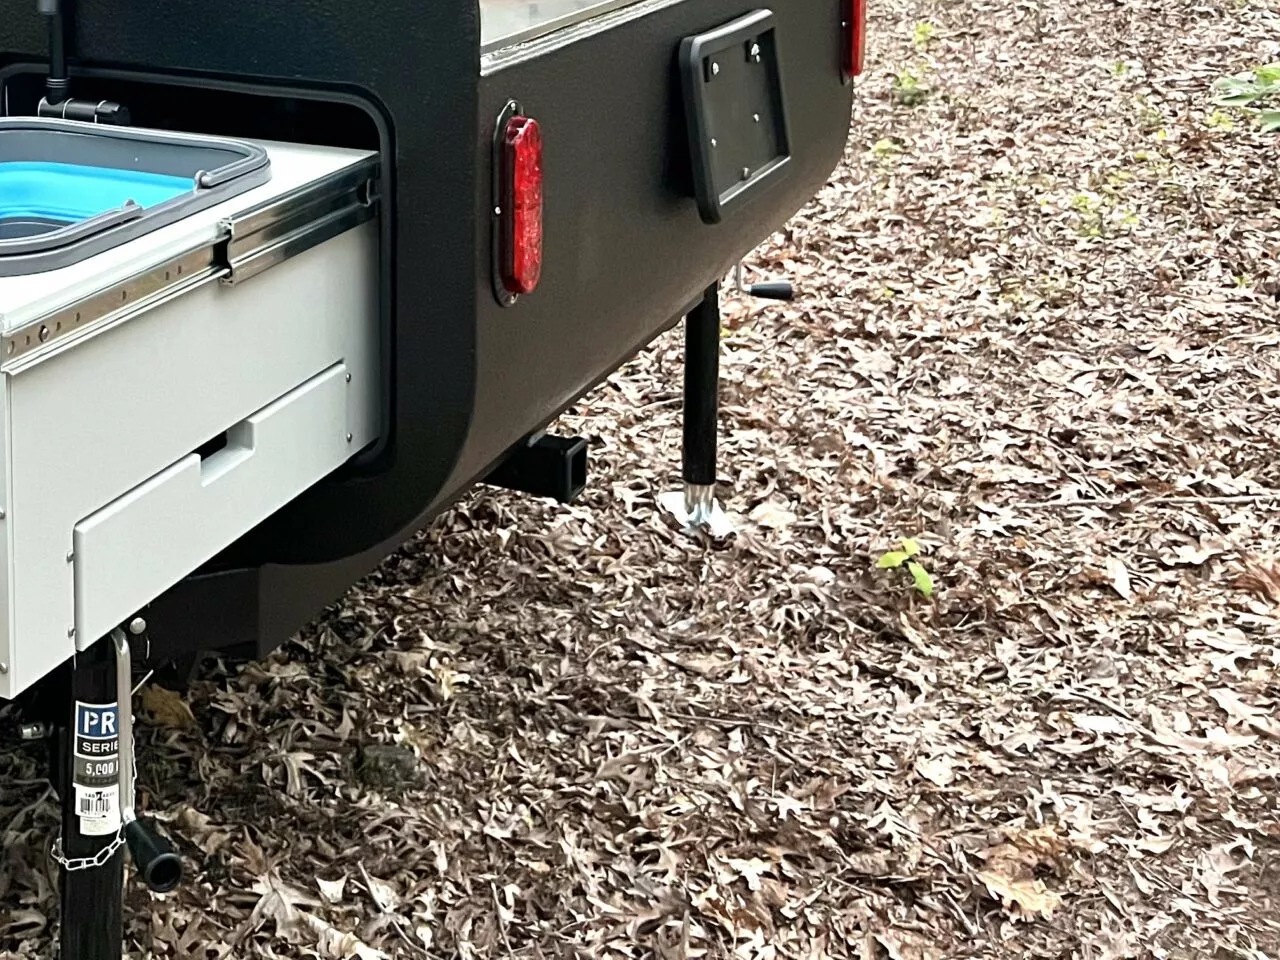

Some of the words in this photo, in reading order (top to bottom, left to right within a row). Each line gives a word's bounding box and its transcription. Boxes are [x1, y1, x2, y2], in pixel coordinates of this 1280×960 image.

[84, 711, 115, 735] PR
[82, 741, 119, 753] SERIE
[86, 762, 113, 777] 5,000
